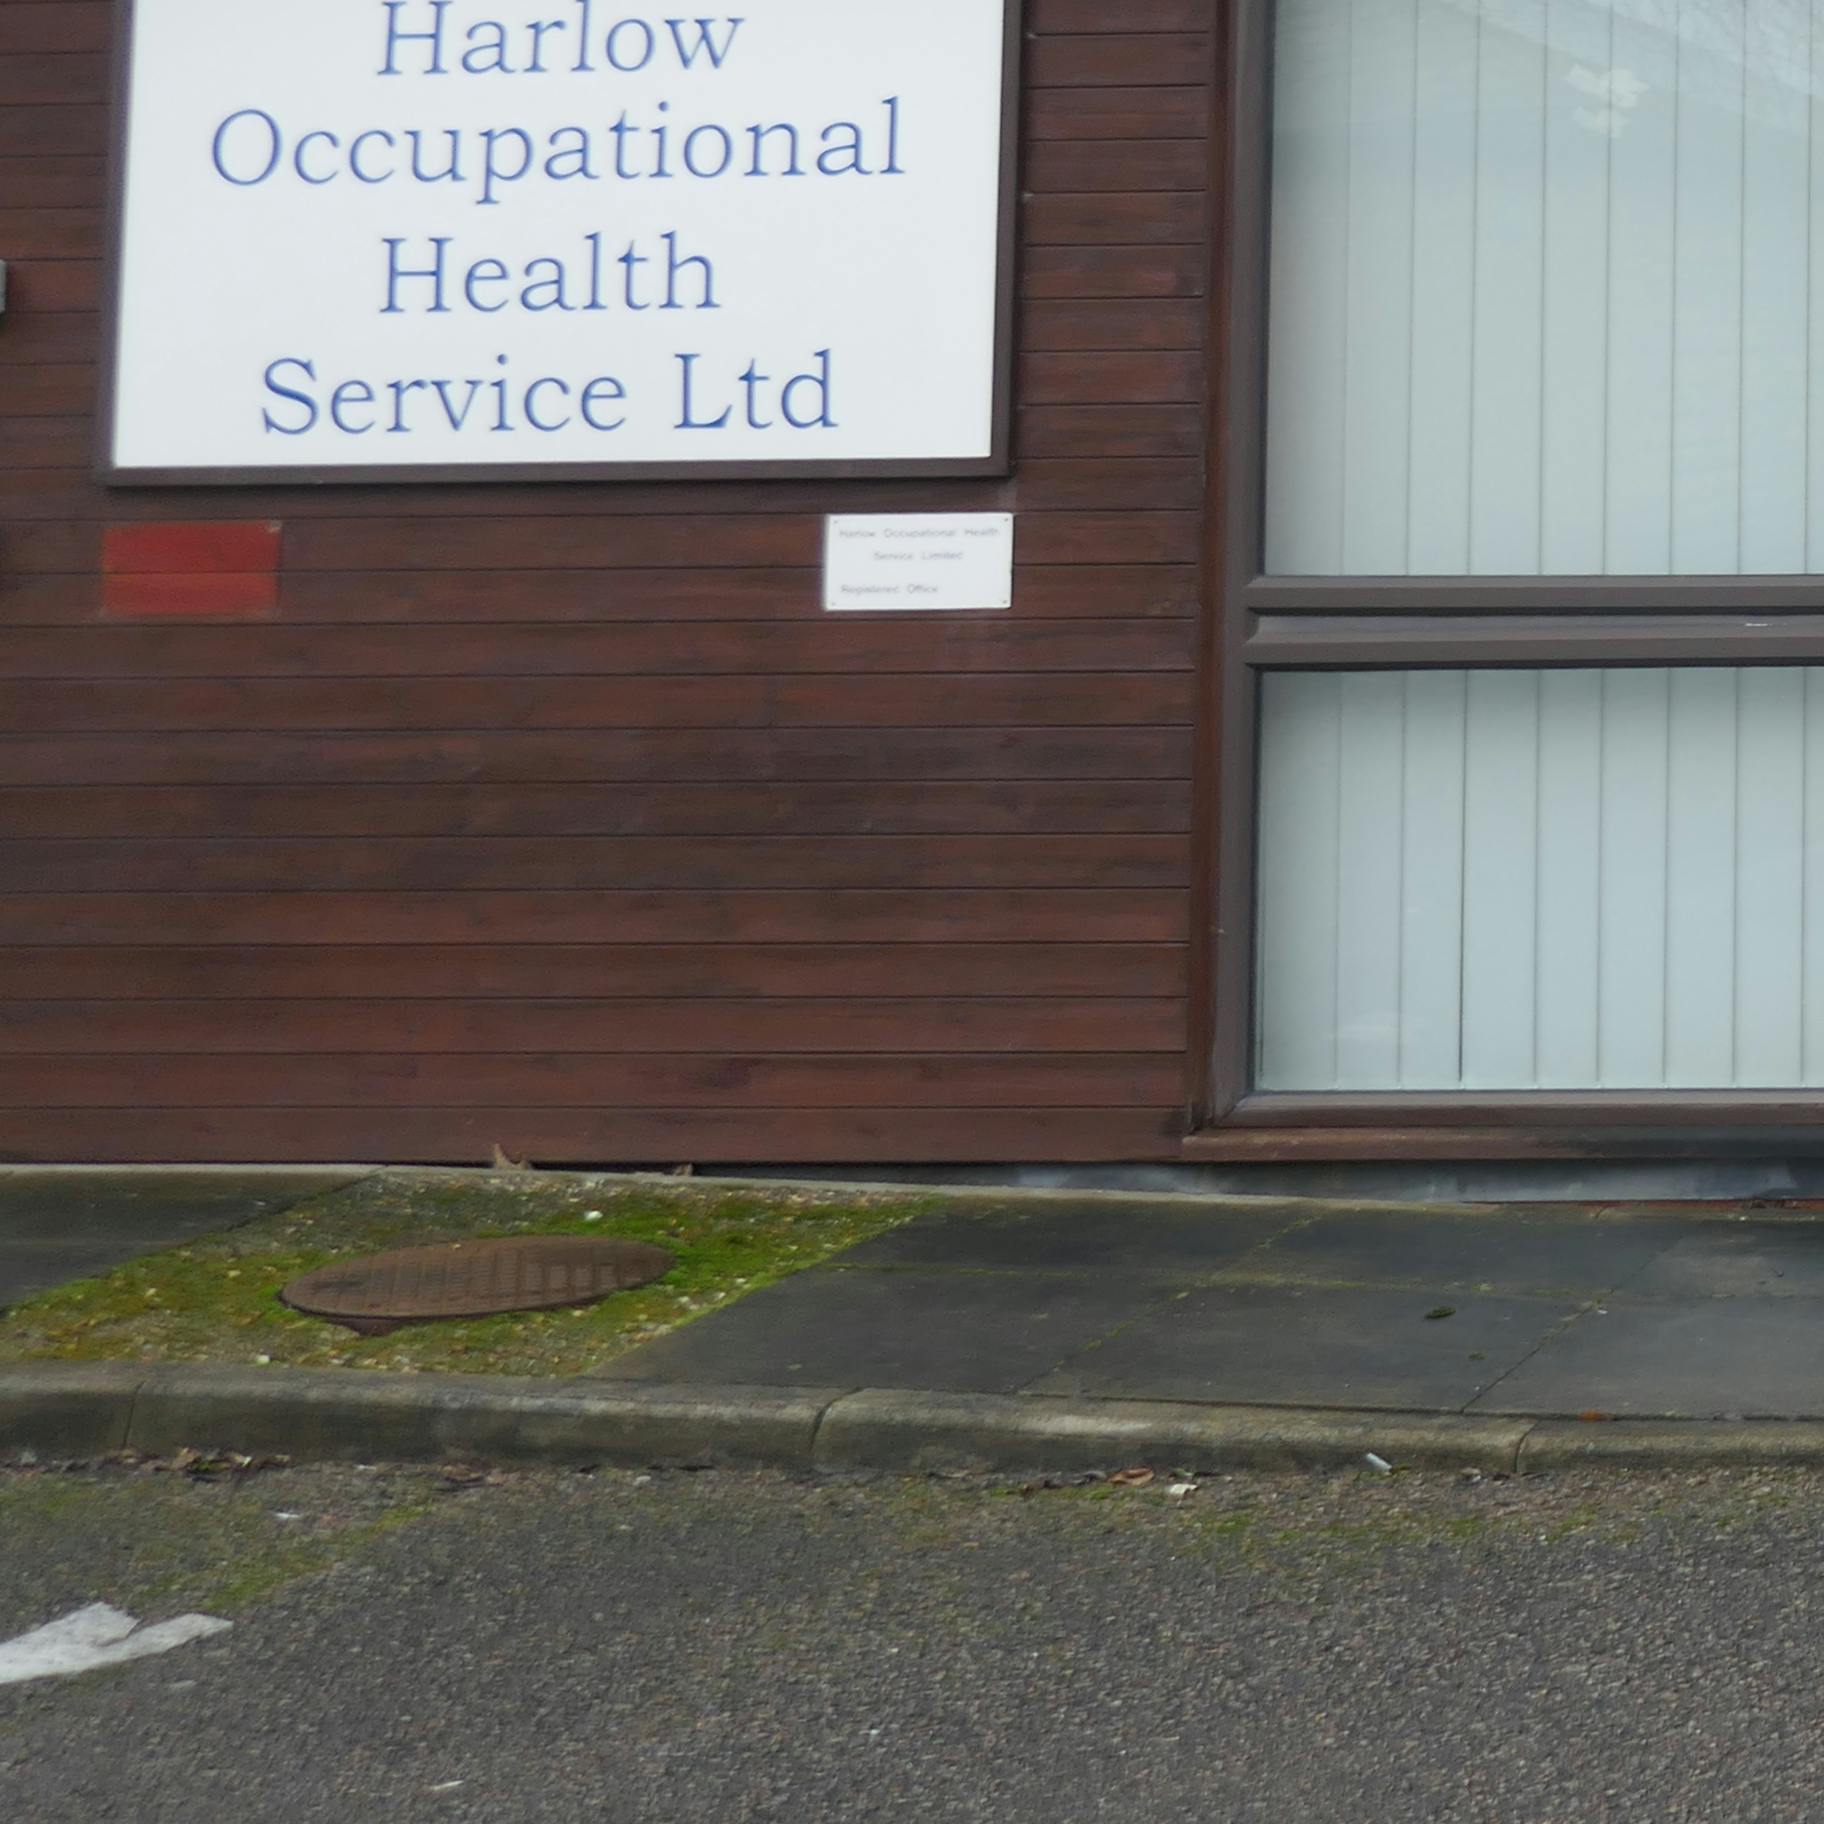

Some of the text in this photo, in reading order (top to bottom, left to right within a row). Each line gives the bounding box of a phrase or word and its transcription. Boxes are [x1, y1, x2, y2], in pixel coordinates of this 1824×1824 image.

[210, 97, 907, 204] Occupational
[379, 230, 720, 314] Health
[261, 348, 838, 436] Service Ltd
